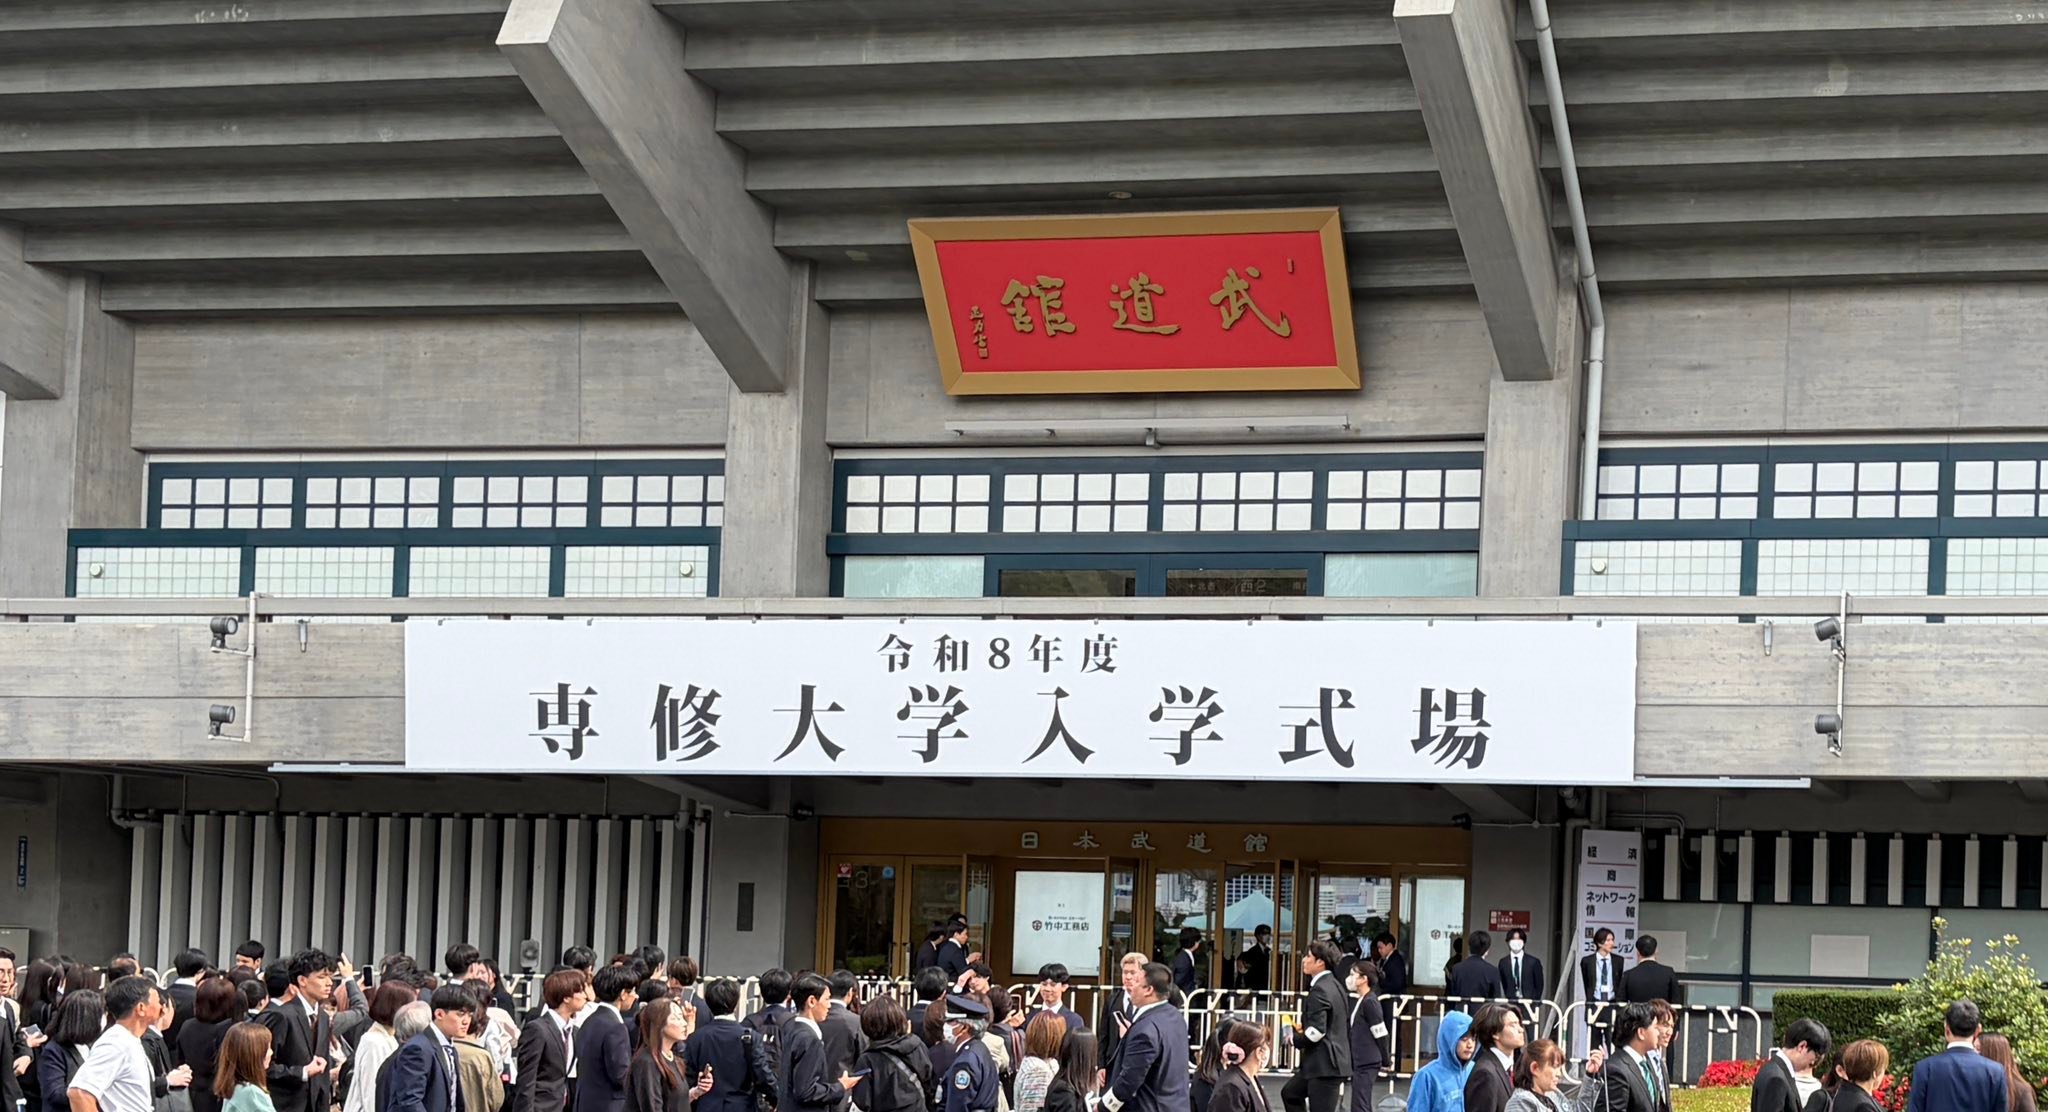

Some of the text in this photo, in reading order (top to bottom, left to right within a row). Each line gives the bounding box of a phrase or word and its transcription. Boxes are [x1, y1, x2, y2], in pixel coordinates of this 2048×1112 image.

[877, 633, 1119, 674] 令和8年度
[528, 682, 1492, 769] 専修大学入学式場
[1021, 831, 1269, 853] 日本武道館
[1586, 891, 1636, 904] ネットワーク
[1044, 921, 1090, 931] 竹中工務店
